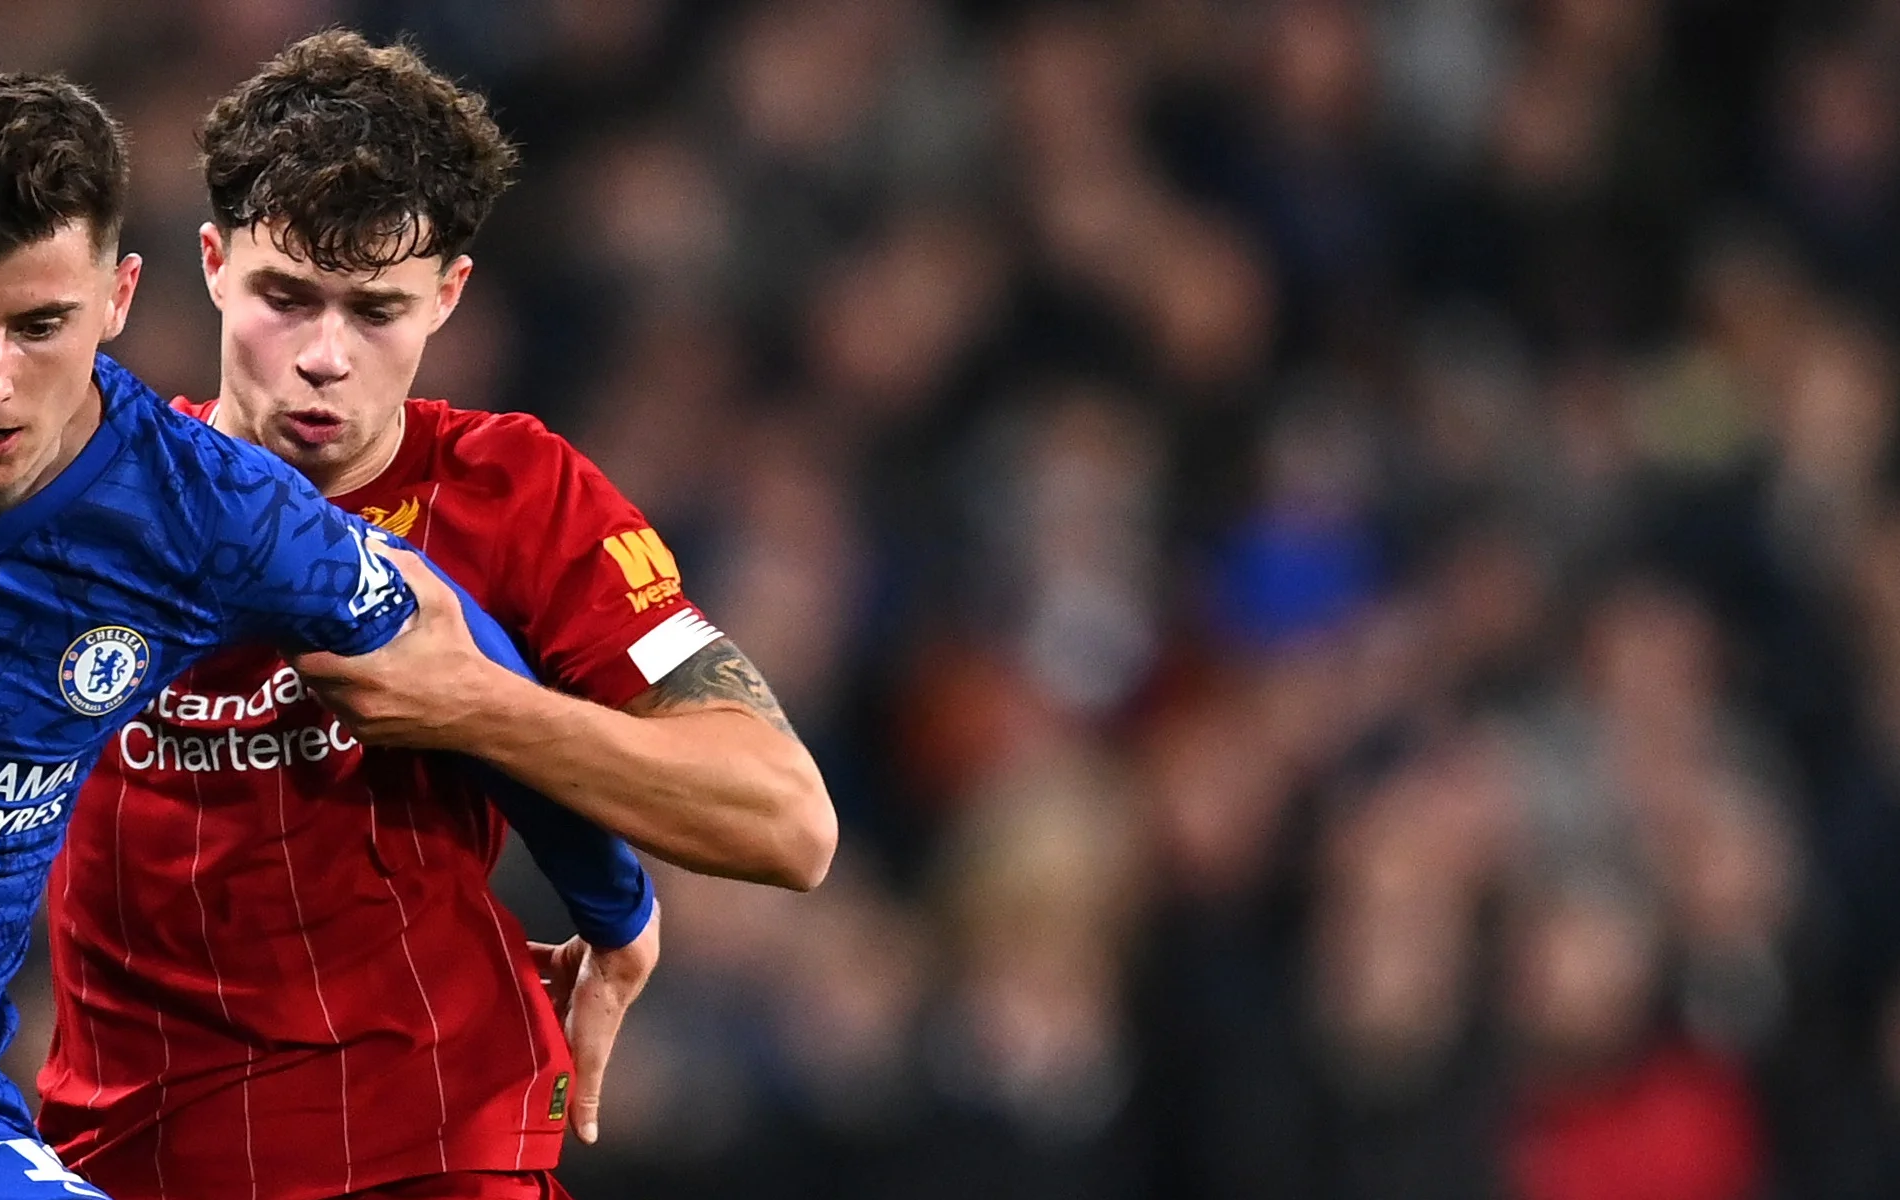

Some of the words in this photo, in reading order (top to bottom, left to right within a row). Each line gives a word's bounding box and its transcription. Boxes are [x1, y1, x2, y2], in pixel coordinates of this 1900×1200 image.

[85, 630, 141, 652] CHELSEA
[68, 691, 102, 711] FOOTBALL
[144, 666, 304, 721] tanda
